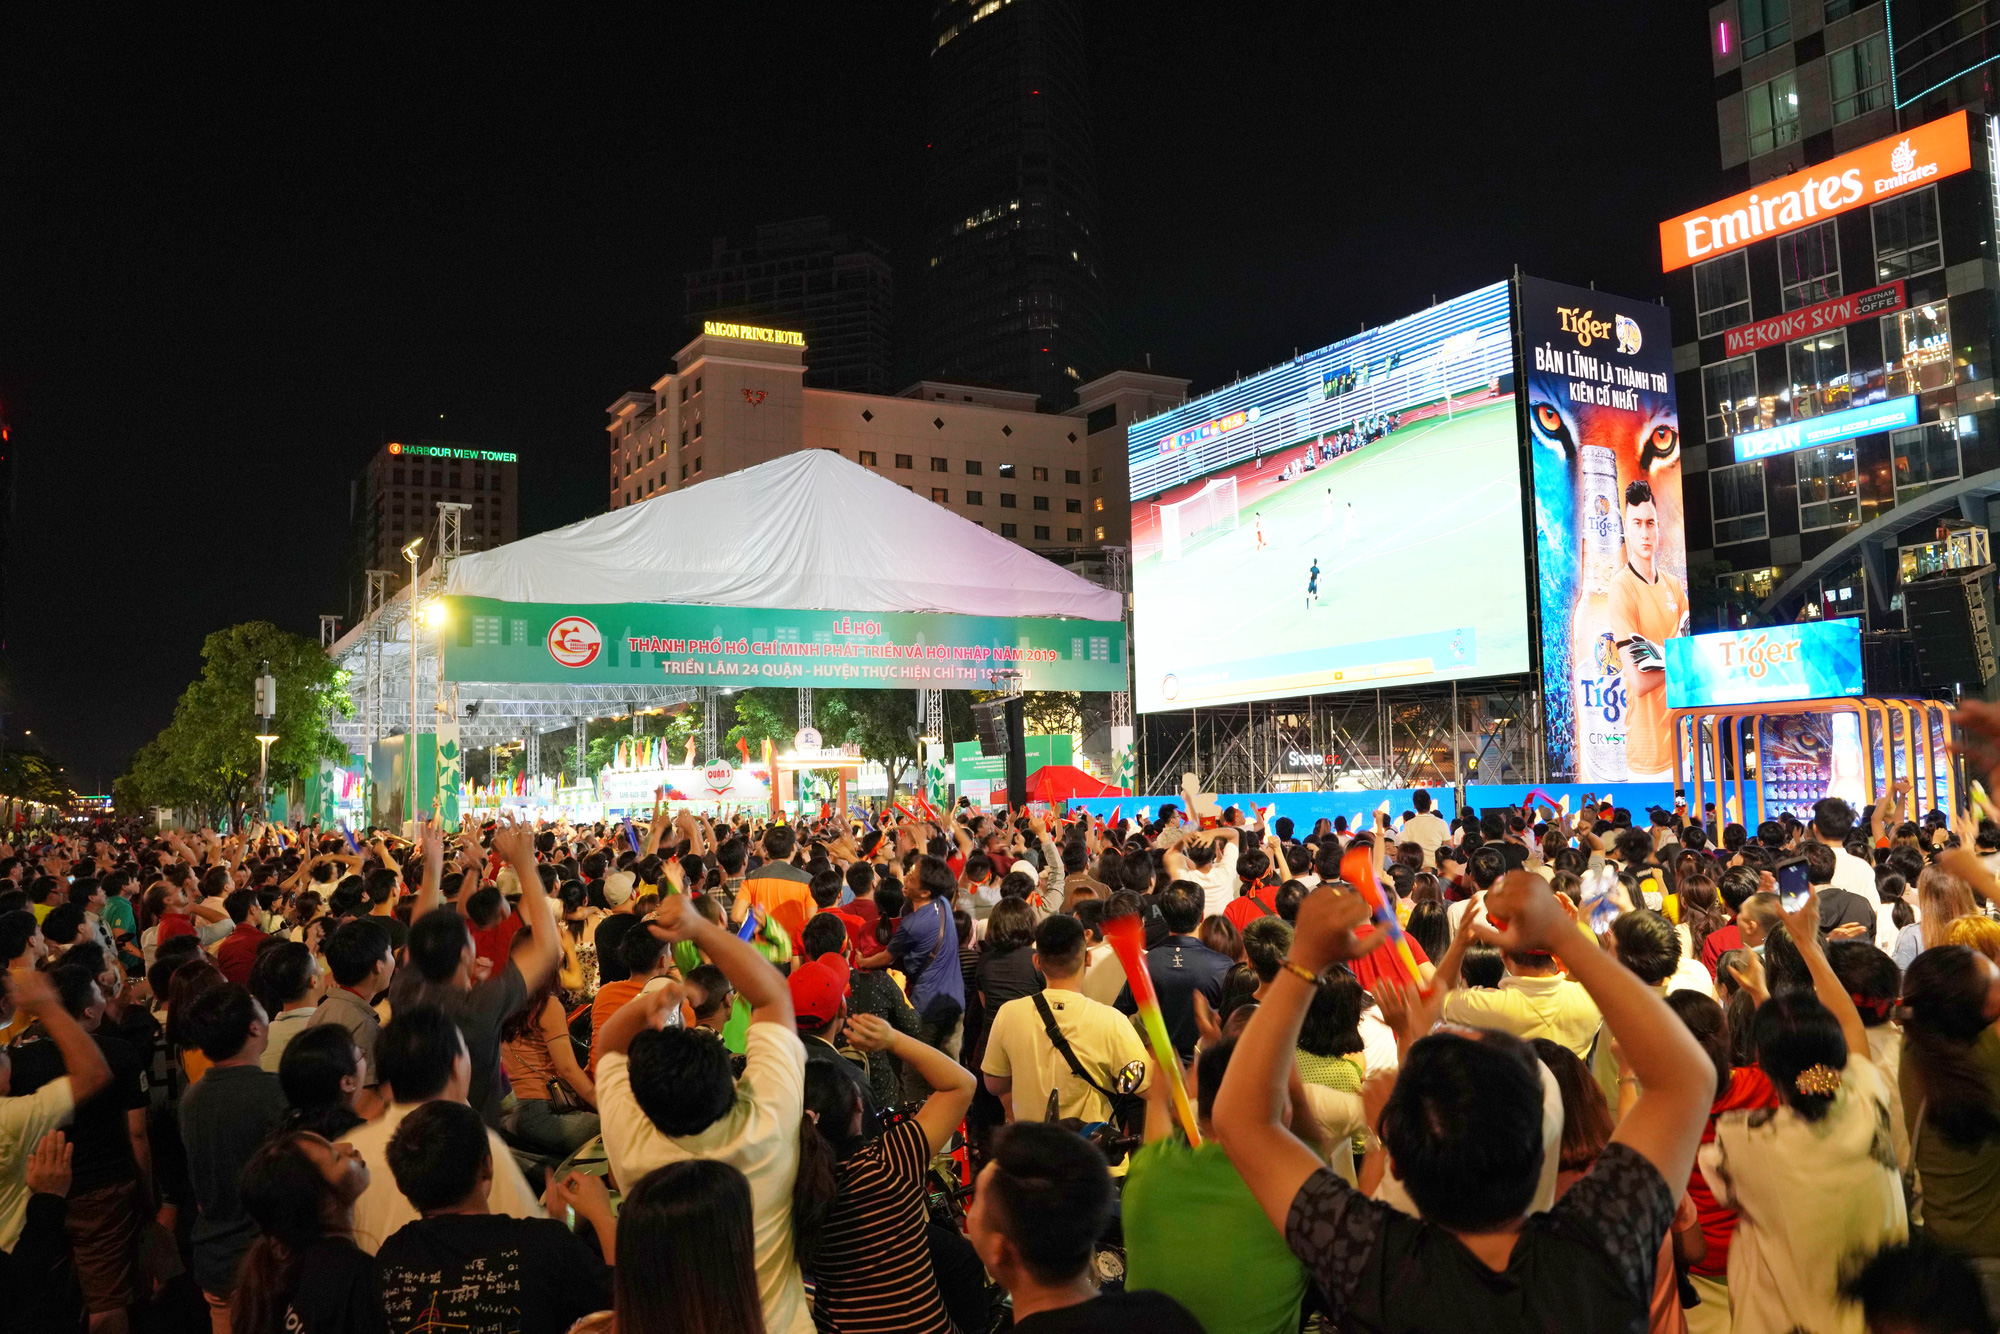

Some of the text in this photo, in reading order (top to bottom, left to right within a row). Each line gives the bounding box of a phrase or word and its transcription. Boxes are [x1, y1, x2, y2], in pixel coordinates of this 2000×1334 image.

[1874, 162, 1938, 194] Emirates
[1683, 168, 1863, 258] Emirates
[1854, 295, 1902, 315] COFFEE
[1858, 289, 1895, 304] VIETNAM
[704, 320, 806, 346] SAIGON PRINCE HOTEL
[1557, 306, 1612, 347] Tiger
[1728, 301, 1851, 351] MEKONG SUN
[1535, 341, 1668, 394] BẢN LĨNH LÀ THÀNH TRÌ
[1569, 380, 1639, 412] KIÊN CỐ NHẤT
[402, 445, 517, 462] HARBOUR VIEW TOWER
[1588, 516, 1618, 537] Tiger
[833, 616, 881, 639] LỄ HỘI
[628, 635, 1057, 663] THÀNH PHỐ HỒ CHÍ MINH PHÁT TRIỂN VÀ HỘI NHẬP NĂM 2019
[1718, 632, 1802, 679] Tiger
[662, 657, 705, 675] TRIỂN
[707, 659, 739, 676] LÃM
[741, 663, 760, 676] 24
[761, 663, 802, 679] QUẬN
[813, 664, 860, 680] HUYỆN
[861, 664, 898, 681] THỰC
[900, 664, 932, 682] HIỆN
[933, 664, 954, 680] CHỈ
[956, 667, 977, 683] THỊ
[283, 1303, 306, 1334] YO
